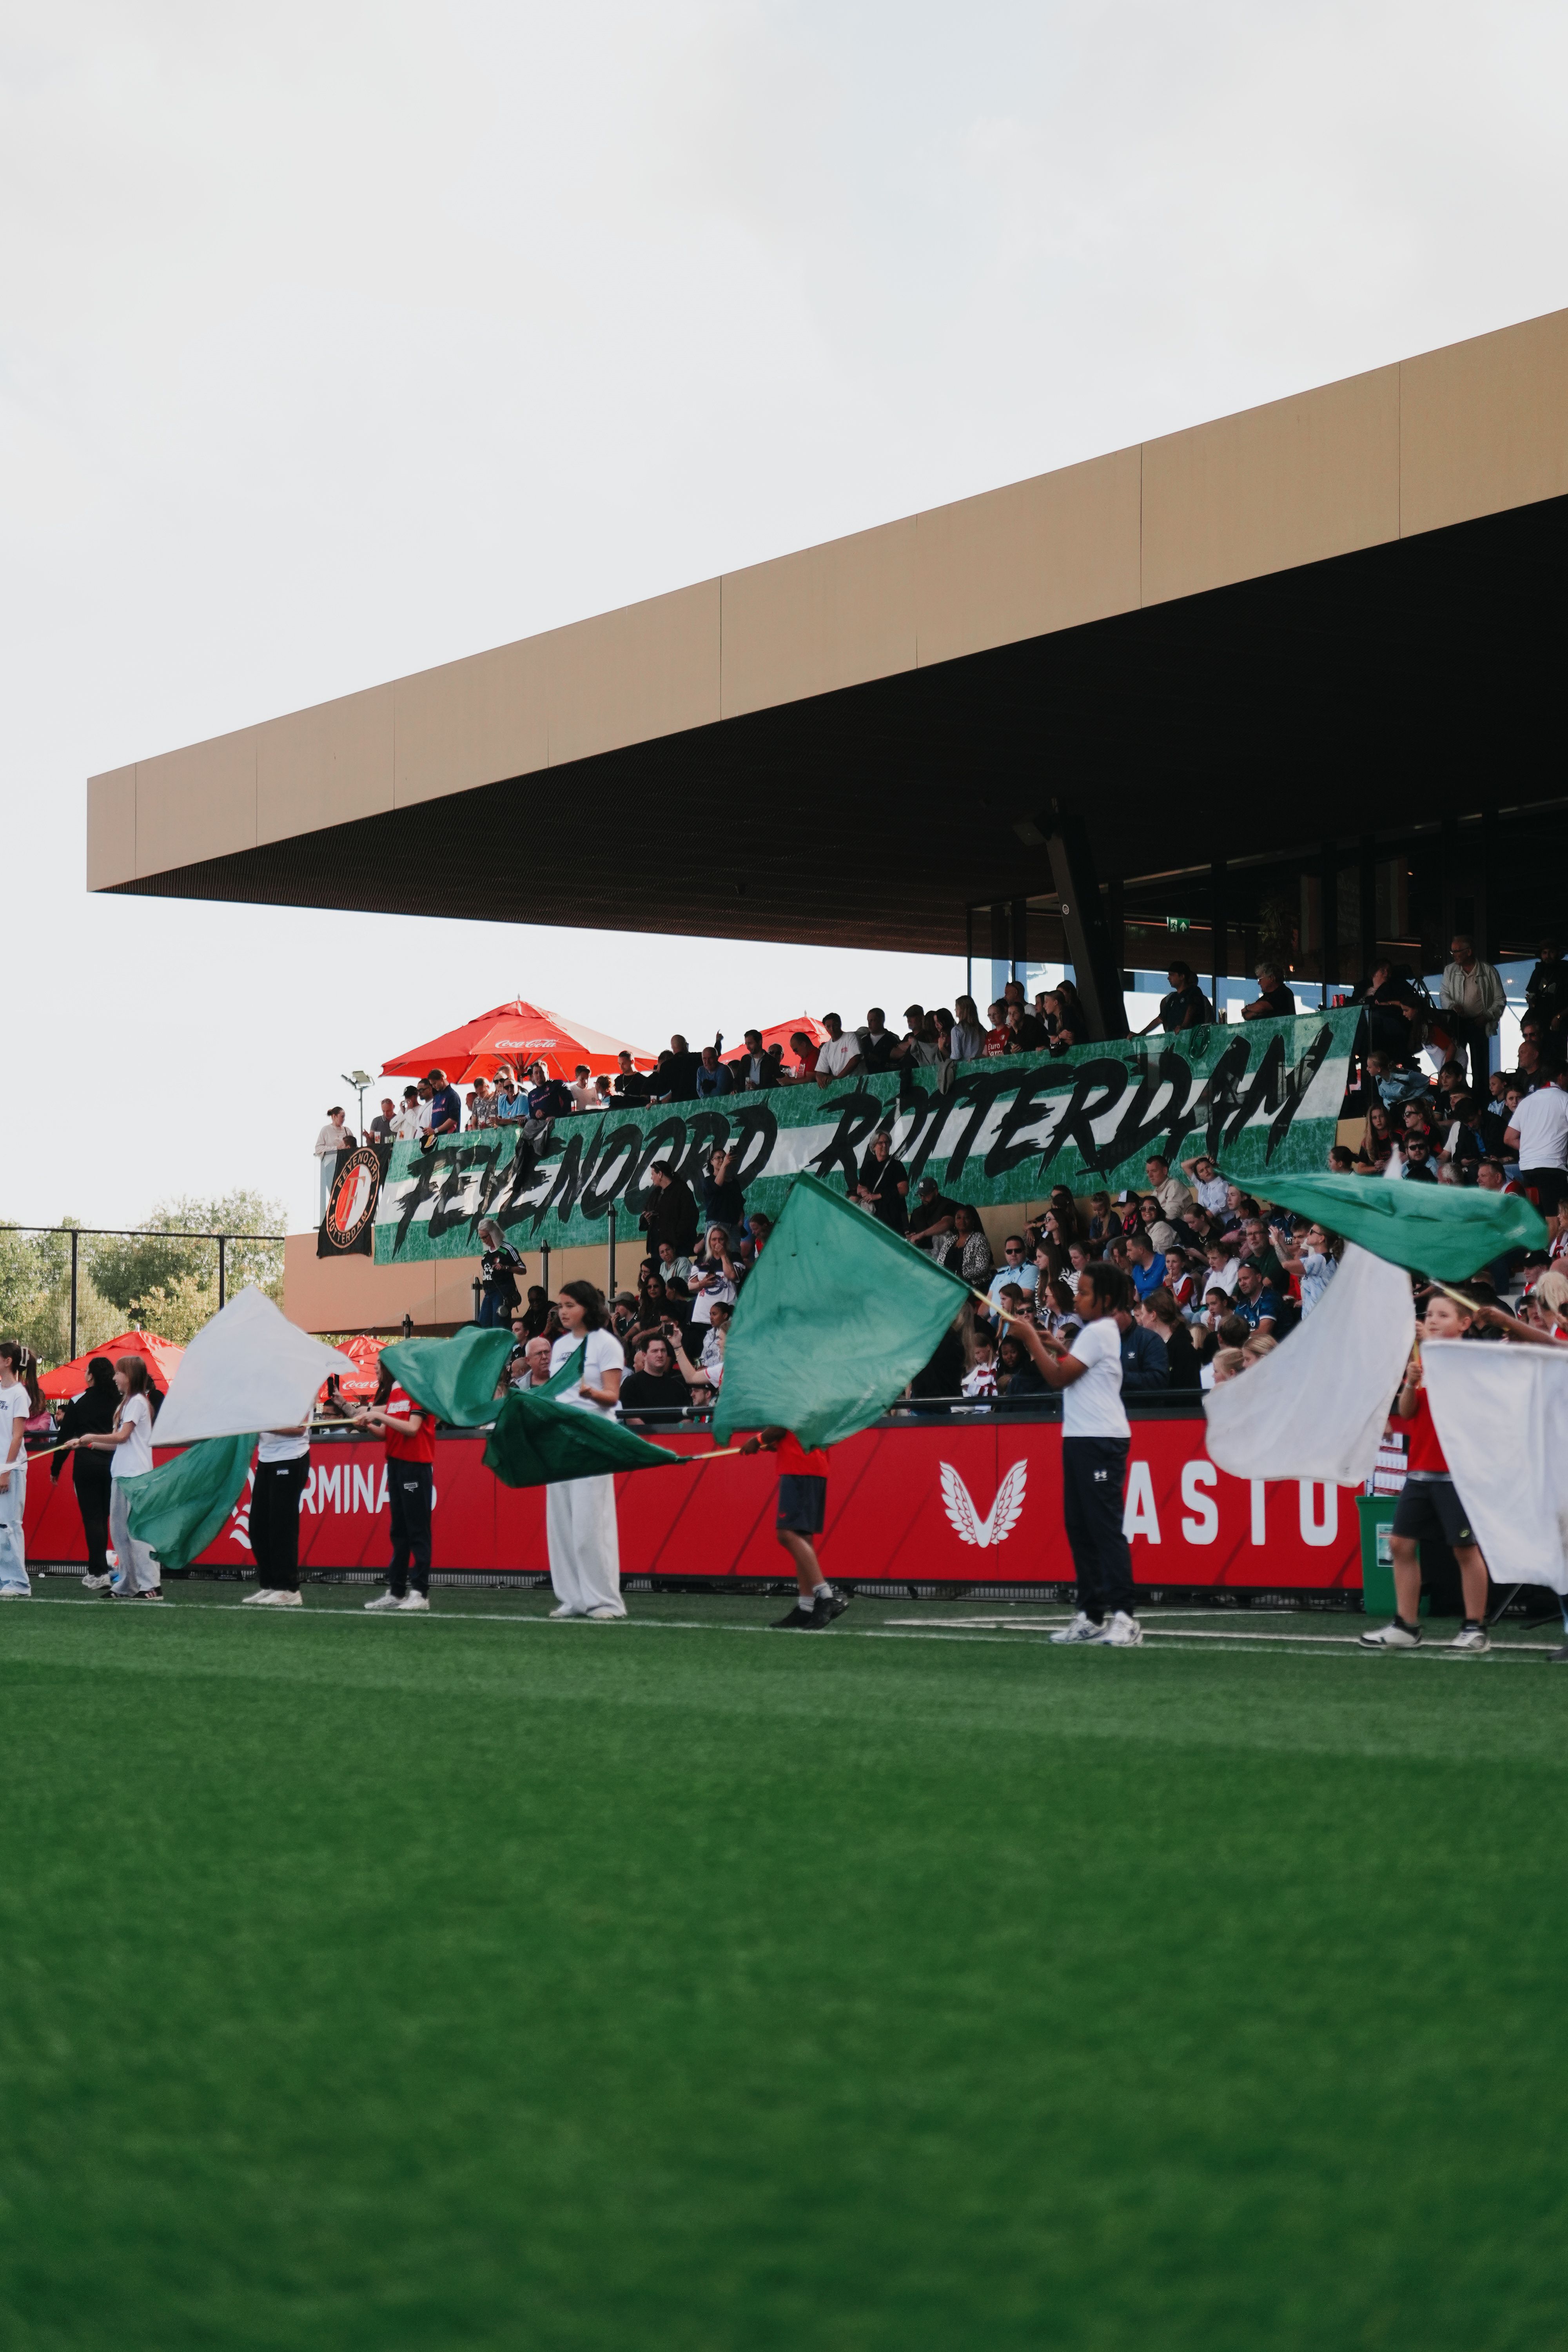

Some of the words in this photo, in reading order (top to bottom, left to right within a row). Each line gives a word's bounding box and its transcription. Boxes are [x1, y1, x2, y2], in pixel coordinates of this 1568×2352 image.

[495, 1039, 559, 1049] Coca-Cola
[392, 1096, 778, 1259] FEYENOORD
[804, 1022, 1334, 1191] ROTTERDAM
[337, 1152, 378, 1189] FEYENOORD
[329, 1209, 368, 1244] ROTTERDAM
